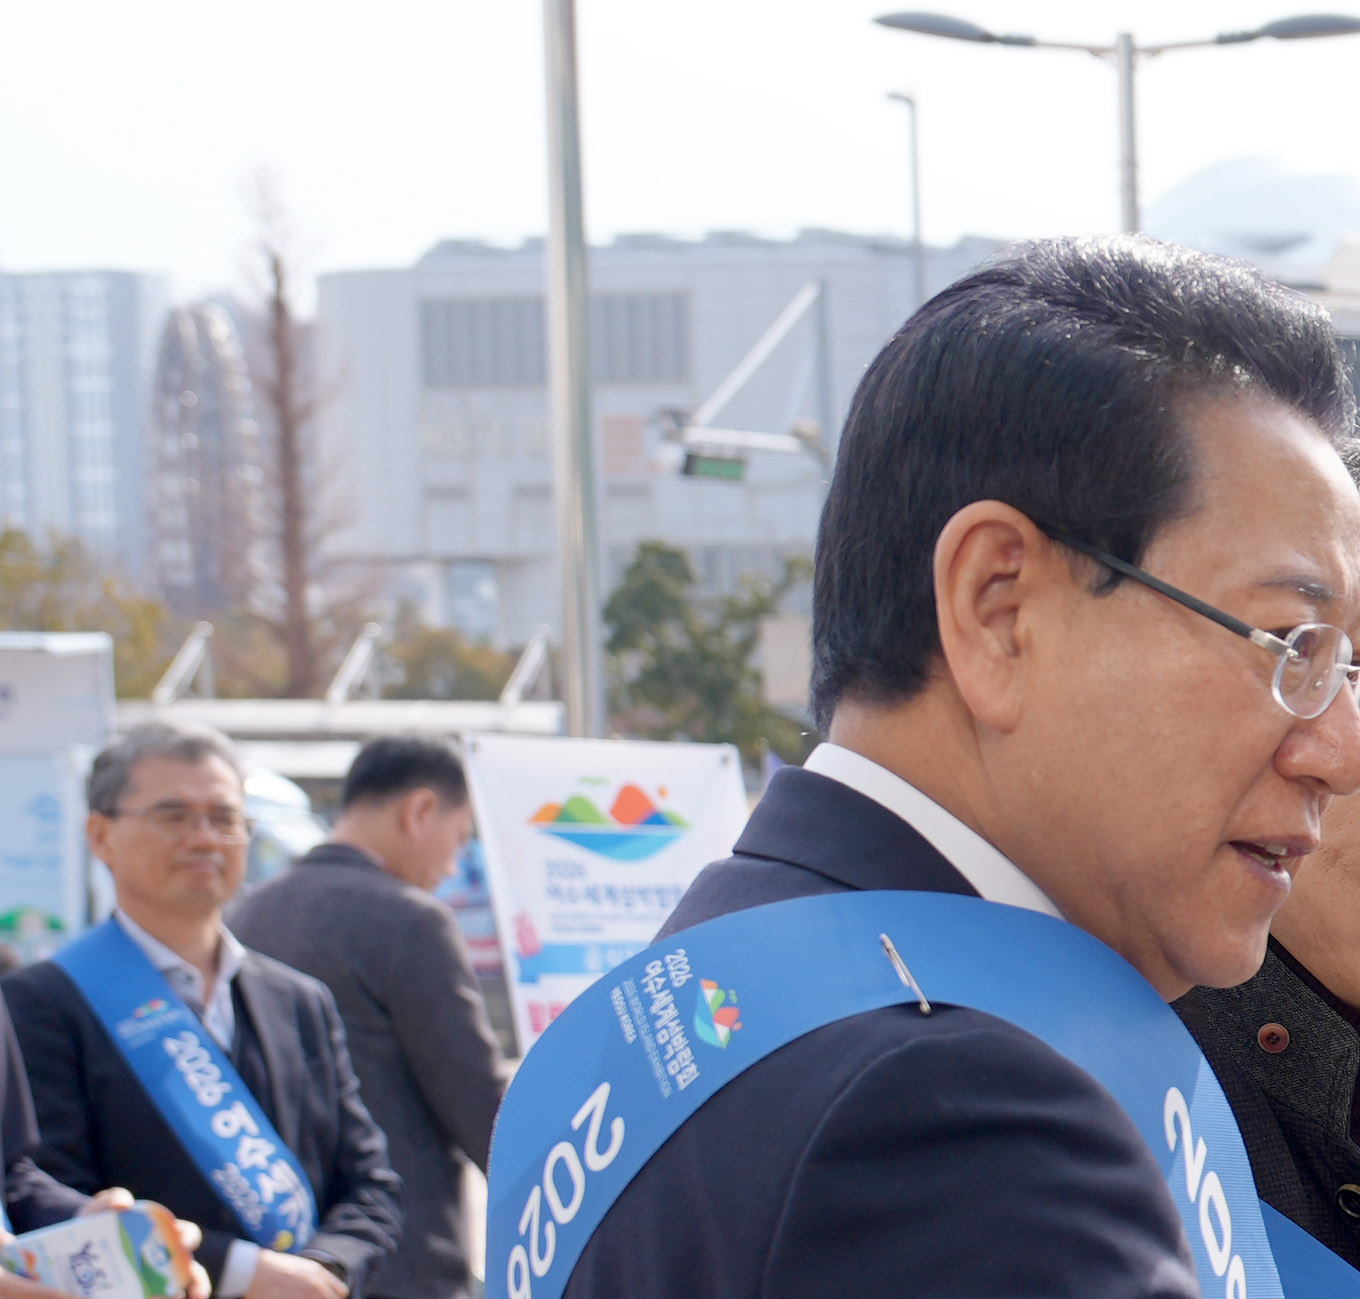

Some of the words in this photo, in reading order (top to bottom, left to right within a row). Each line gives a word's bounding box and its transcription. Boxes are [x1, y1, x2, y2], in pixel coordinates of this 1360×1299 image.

[664, 947, 695, 988] 2026
[641, 959, 701, 1091] 여수세계섬박람회
[160, 1030, 225, 1108] 2026
